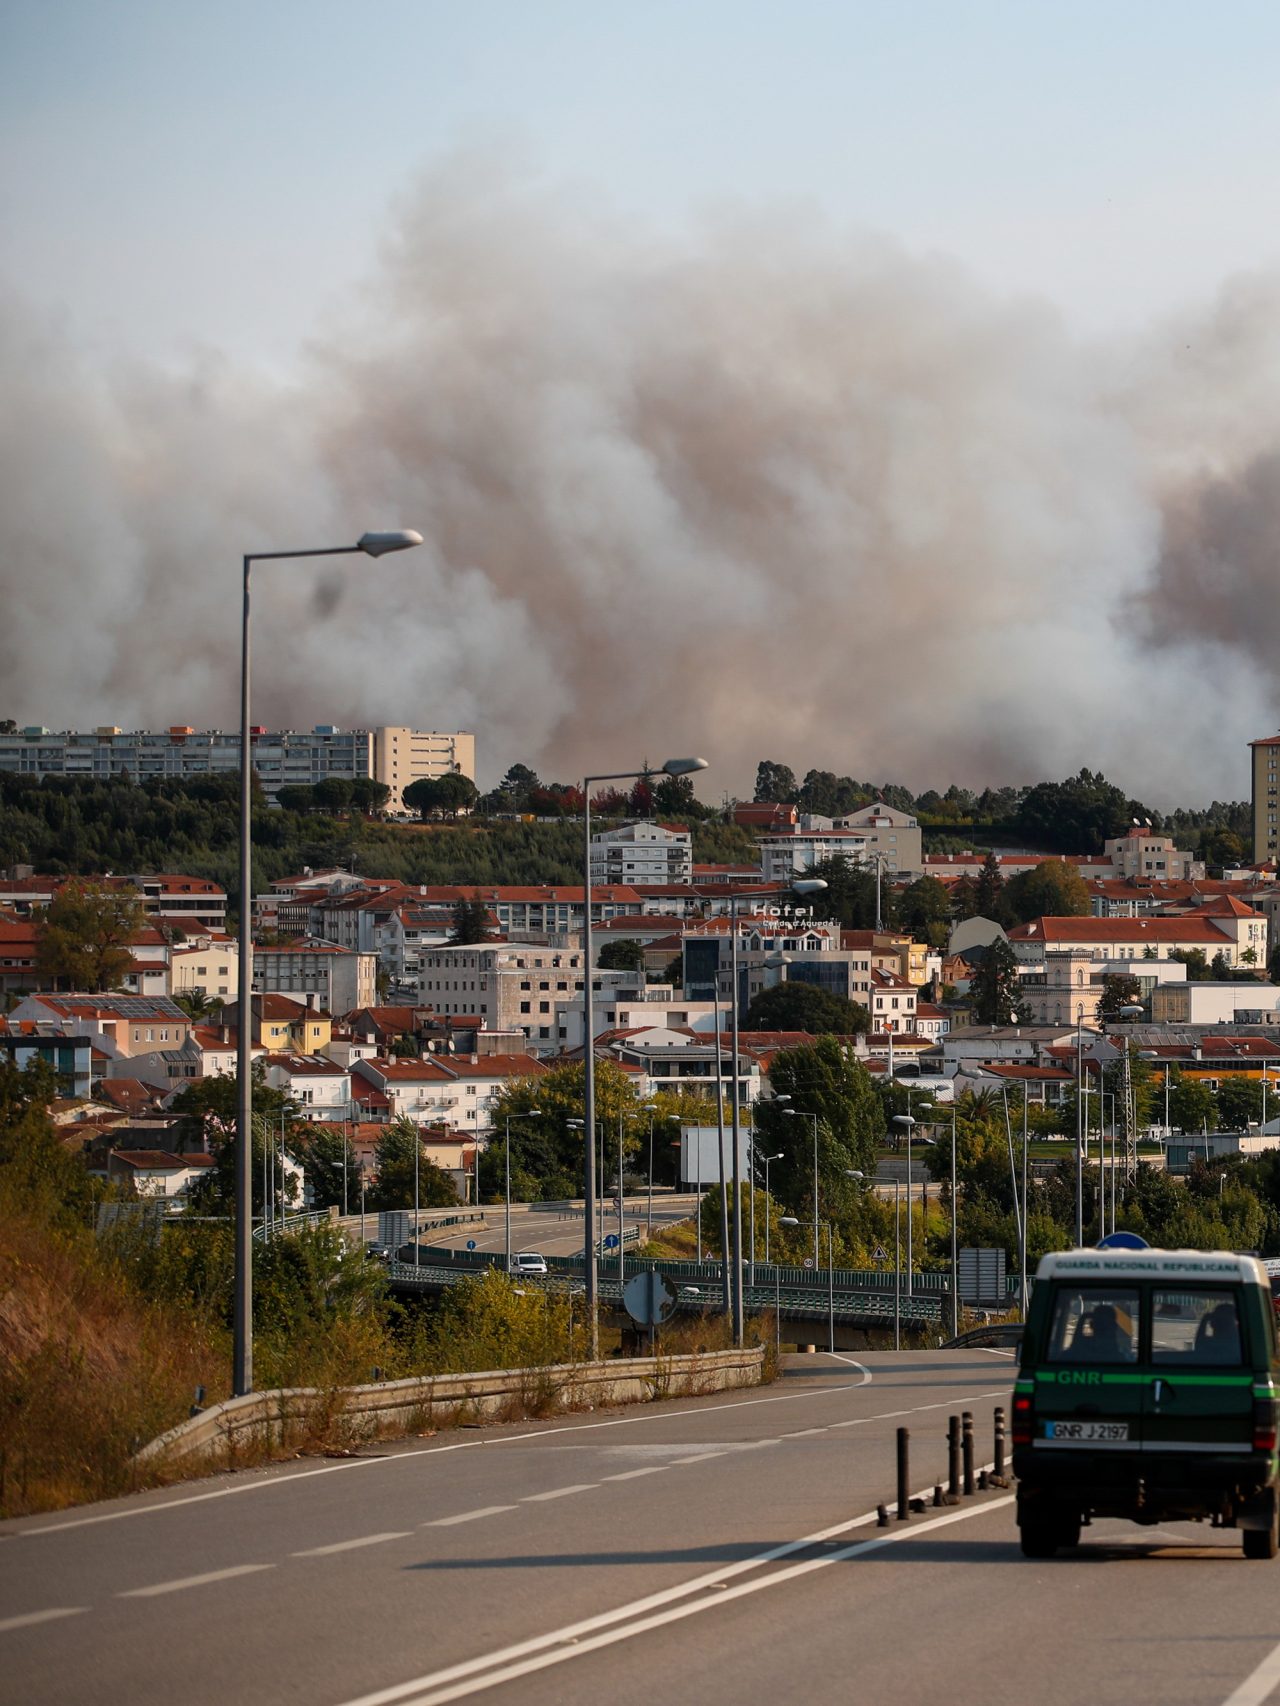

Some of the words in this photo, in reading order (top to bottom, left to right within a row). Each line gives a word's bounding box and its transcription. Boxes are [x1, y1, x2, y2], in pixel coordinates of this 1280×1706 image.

[753, 904, 813, 917] Hotel
[1056, 1261, 1100, 1270] GUARDA
[1104, 1262, 1158, 1271] NACIONAL
[1163, 1263, 1240, 1273] REPUBLICANA
[1057, 1371, 1101, 1384] GNR
[1055, 1424, 1083, 1437] GNR
